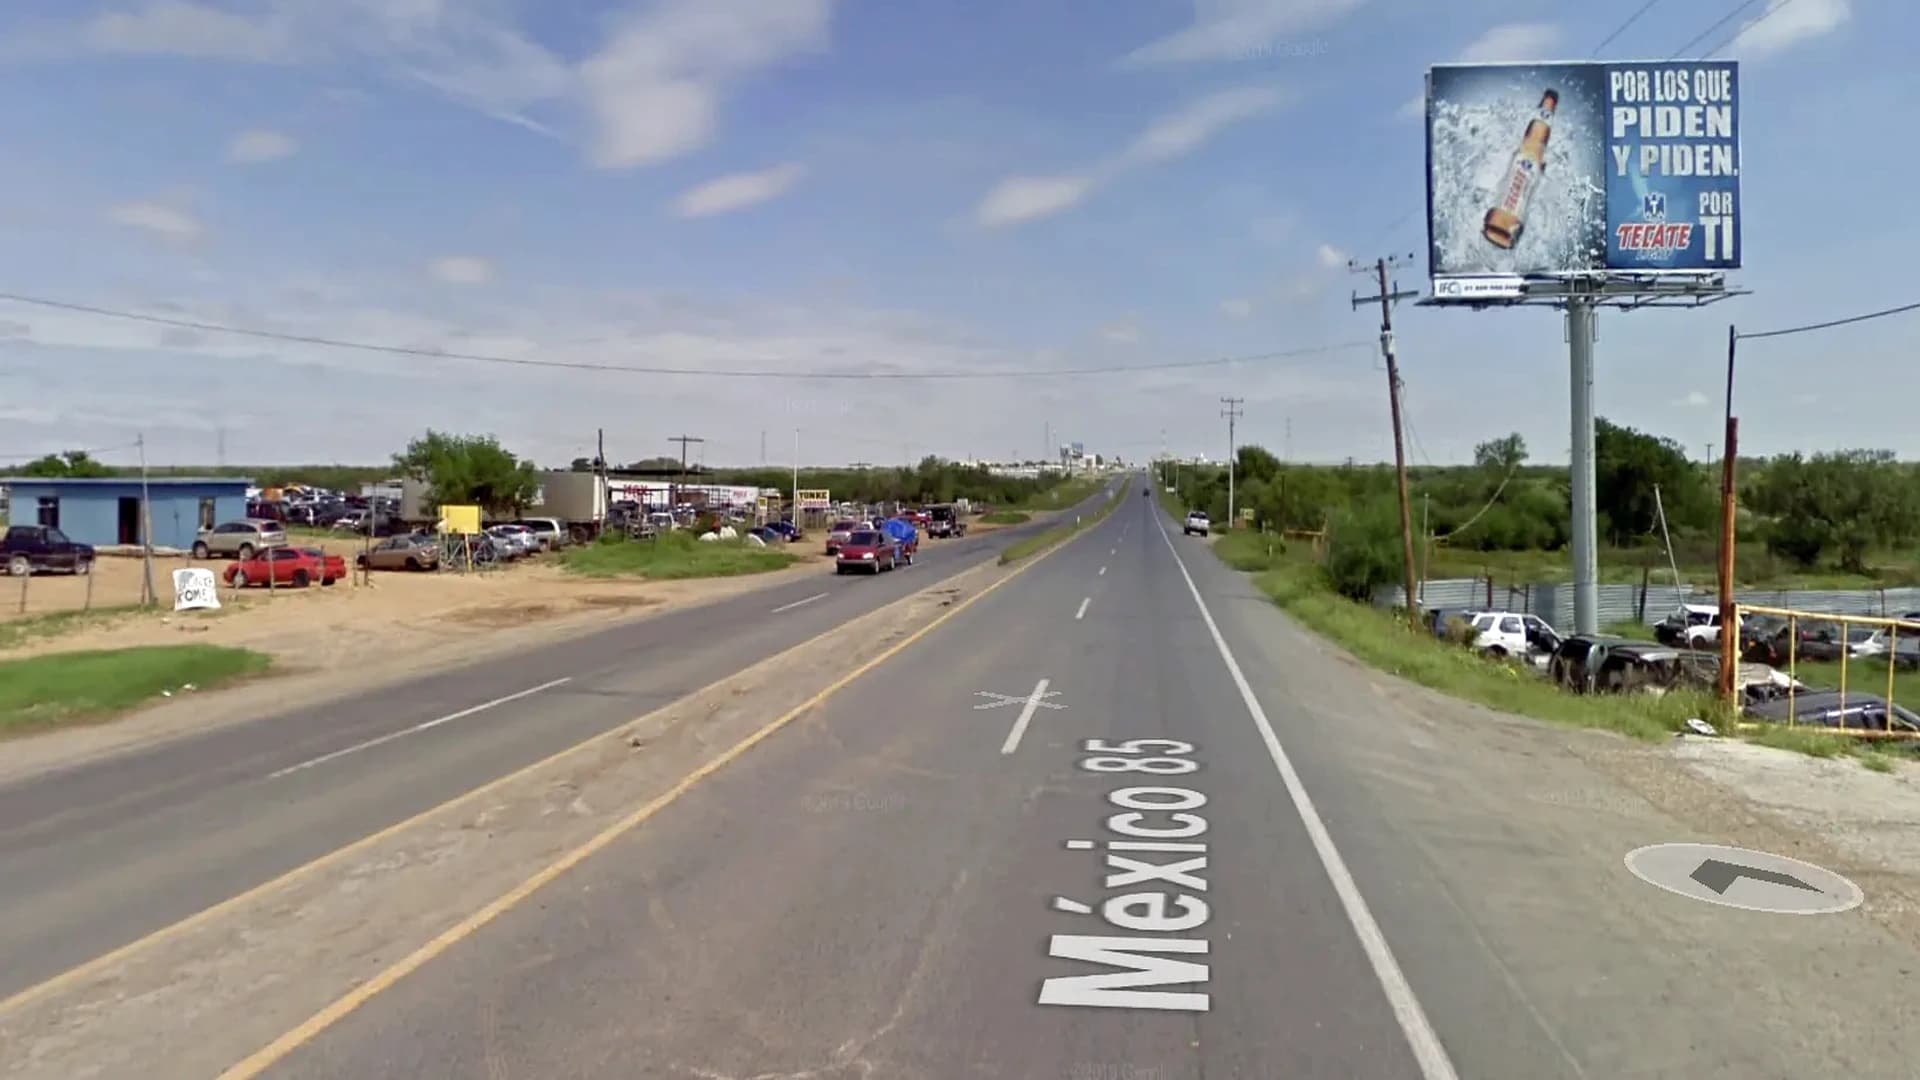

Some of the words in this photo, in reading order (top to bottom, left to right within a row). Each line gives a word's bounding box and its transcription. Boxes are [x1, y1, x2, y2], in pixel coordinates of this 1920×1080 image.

[1611, 70, 1650, 102] POR
[1654, 69, 1690, 102] LOS
[1694, 69, 1732, 105] QUE
[1613, 105, 1732, 138] PIDEN
[1612, 144, 1632, 177] Y
[1640, 144, 1738, 177] PIDEN.
[1699, 191, 1733, 215] POR
[1615, 223, 1693, 250] TECATE
[1699, 215, 1733, 260] TI
